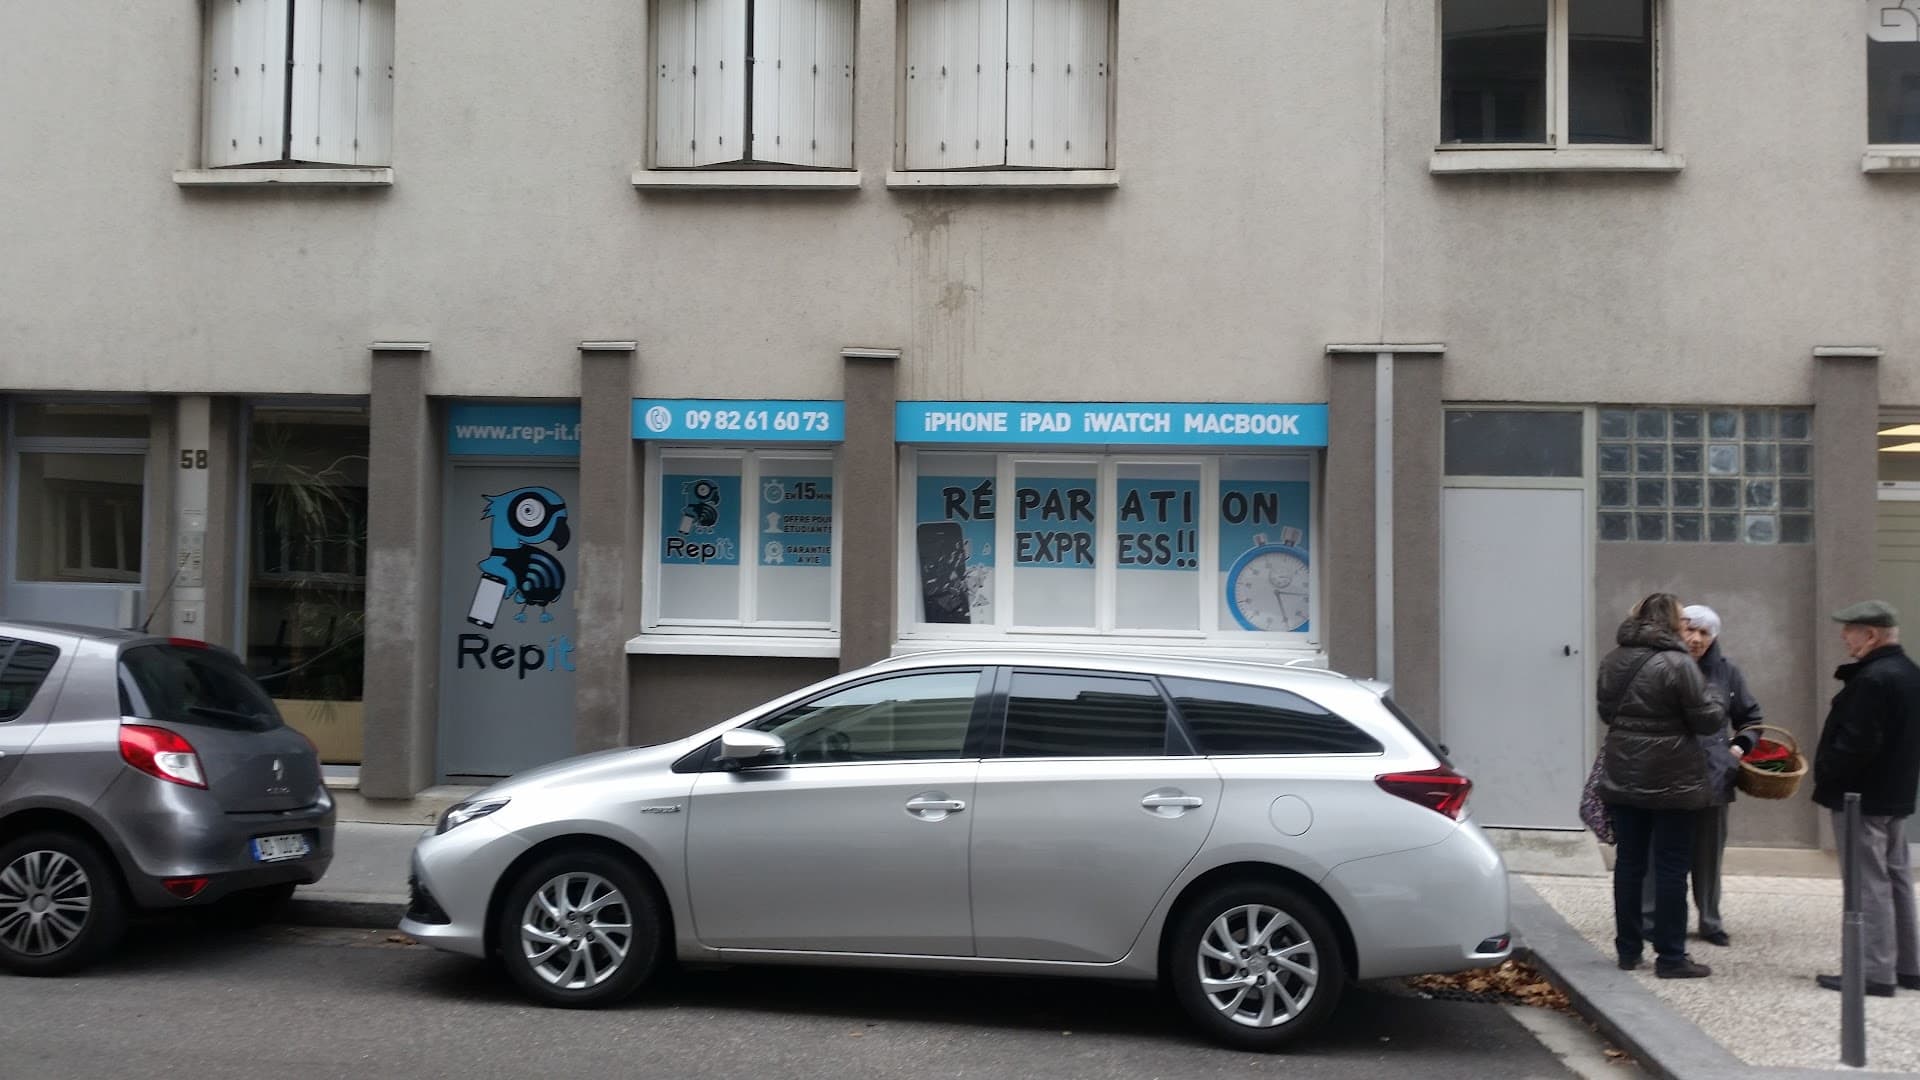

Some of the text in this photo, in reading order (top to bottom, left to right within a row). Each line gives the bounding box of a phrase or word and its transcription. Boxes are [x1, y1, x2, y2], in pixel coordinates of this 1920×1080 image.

[686, 410, 829, 431] 09 82 61 60 73
[925, 412, 1300, 435] iPHONE iPAD iWATCH MACBOOK
[181, 450, 208, 469] 58
[795, 482, 817, 500] 15
[458, 633, 576, 680] Repit
